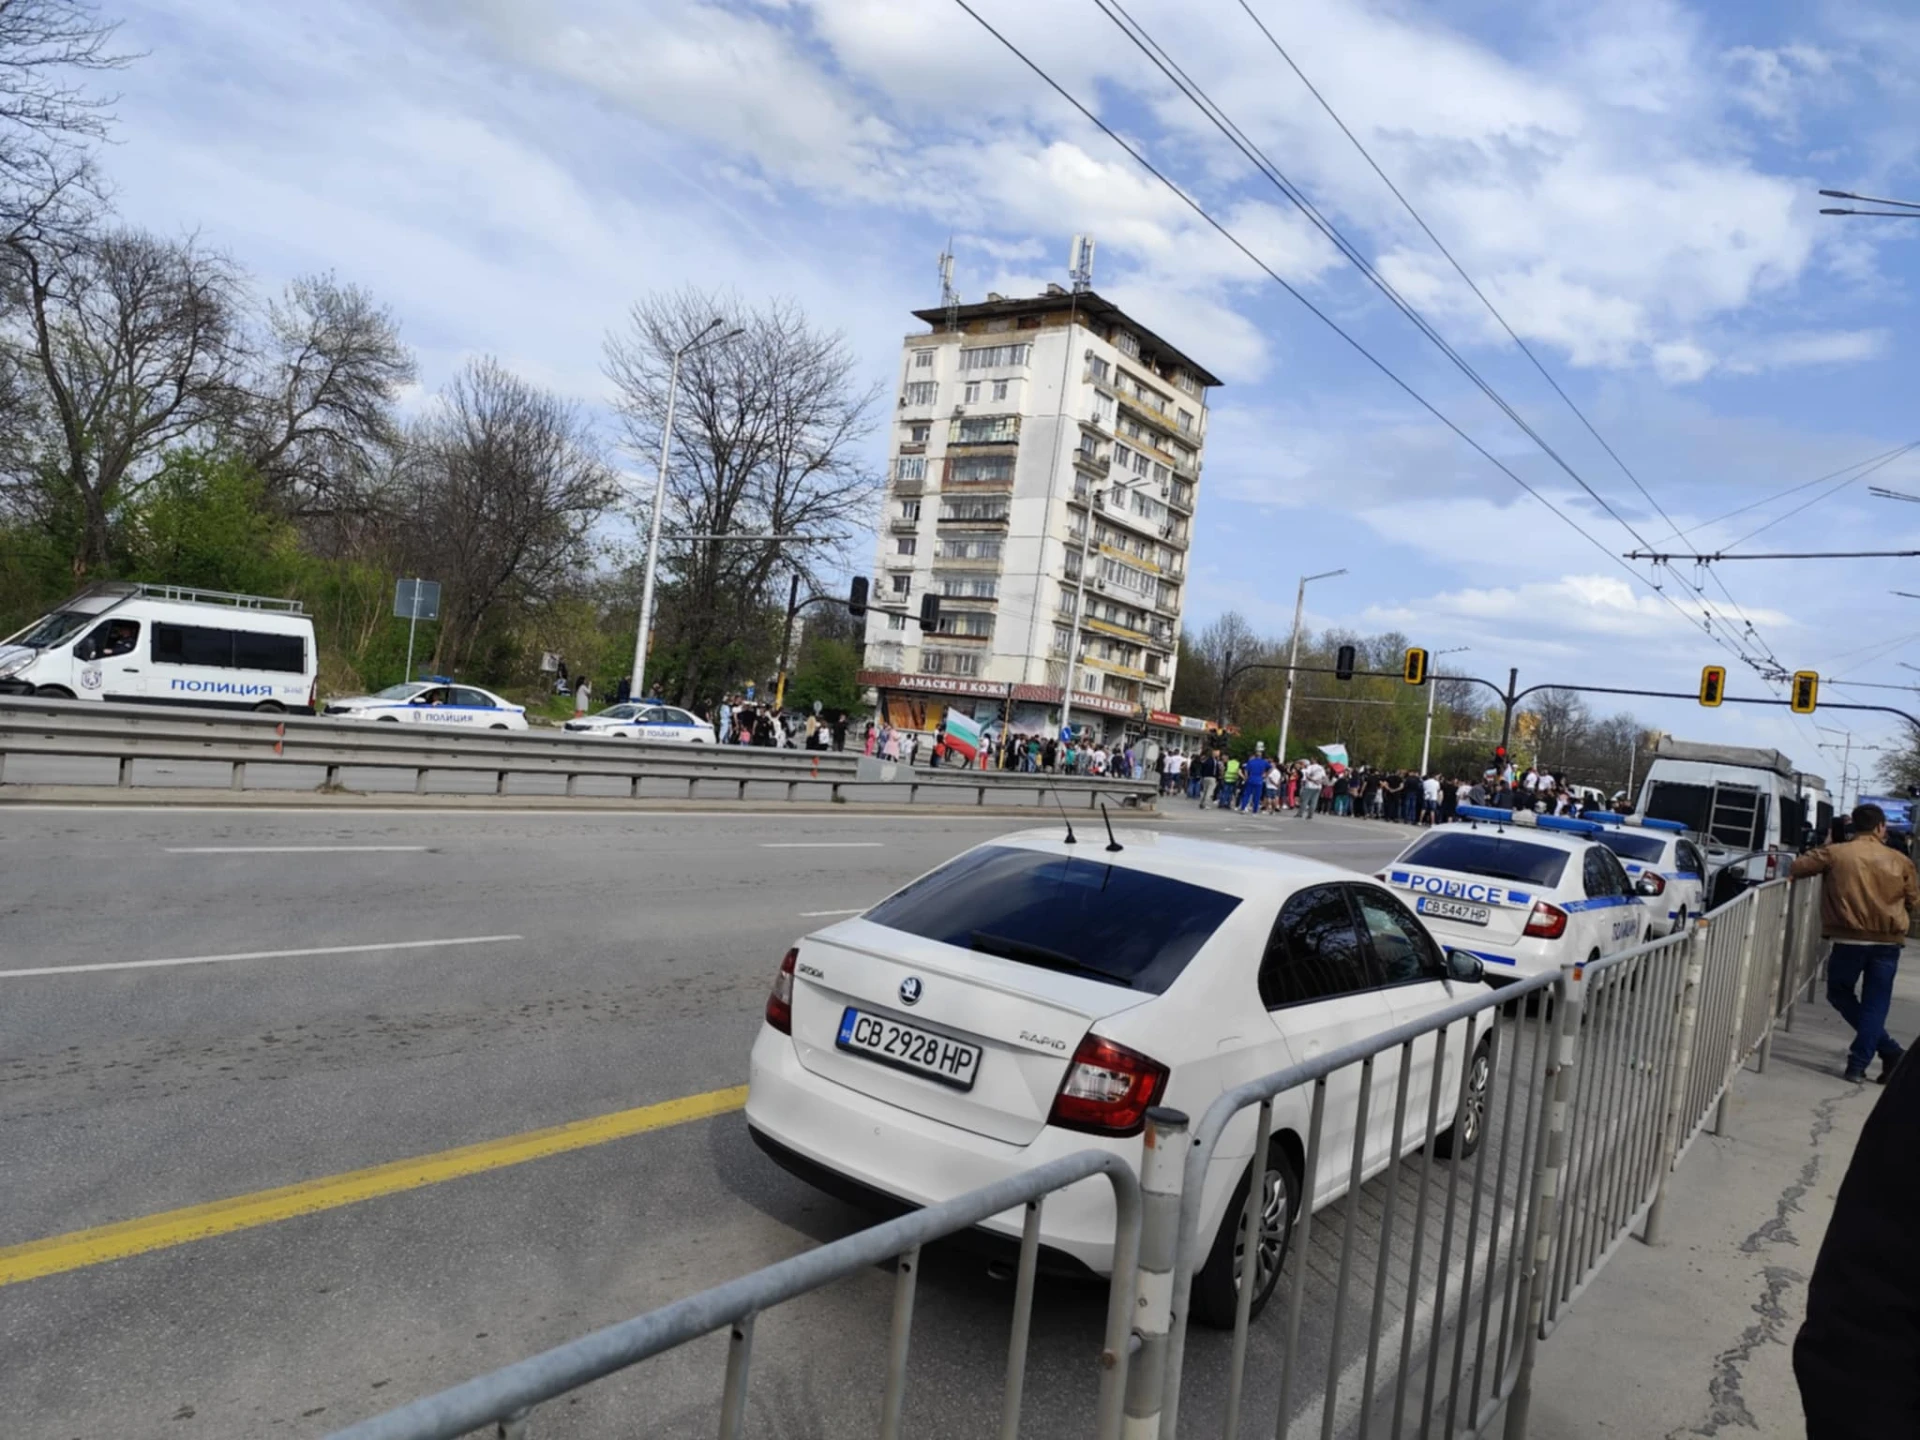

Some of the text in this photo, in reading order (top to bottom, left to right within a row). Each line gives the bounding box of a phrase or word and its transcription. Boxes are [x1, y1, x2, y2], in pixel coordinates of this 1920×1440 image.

[171, 679, 272, 696] ПОЛИЦИЯ
[900, 677, 956, 691] ДАМАСКИ
[425, 713, 473, 722] ПОЛИЦИЯ
[1410, 875, 1502, 904] POLICE
[1425, 900, 1440, 912] CB
[1441, 903, 1470, 916] 5447
[1470, 908, 1487, 919] HP
[854, 1018, 972, 1074] CB 2928 HP
[1020, 1030, 1066, 1050] RAPID
